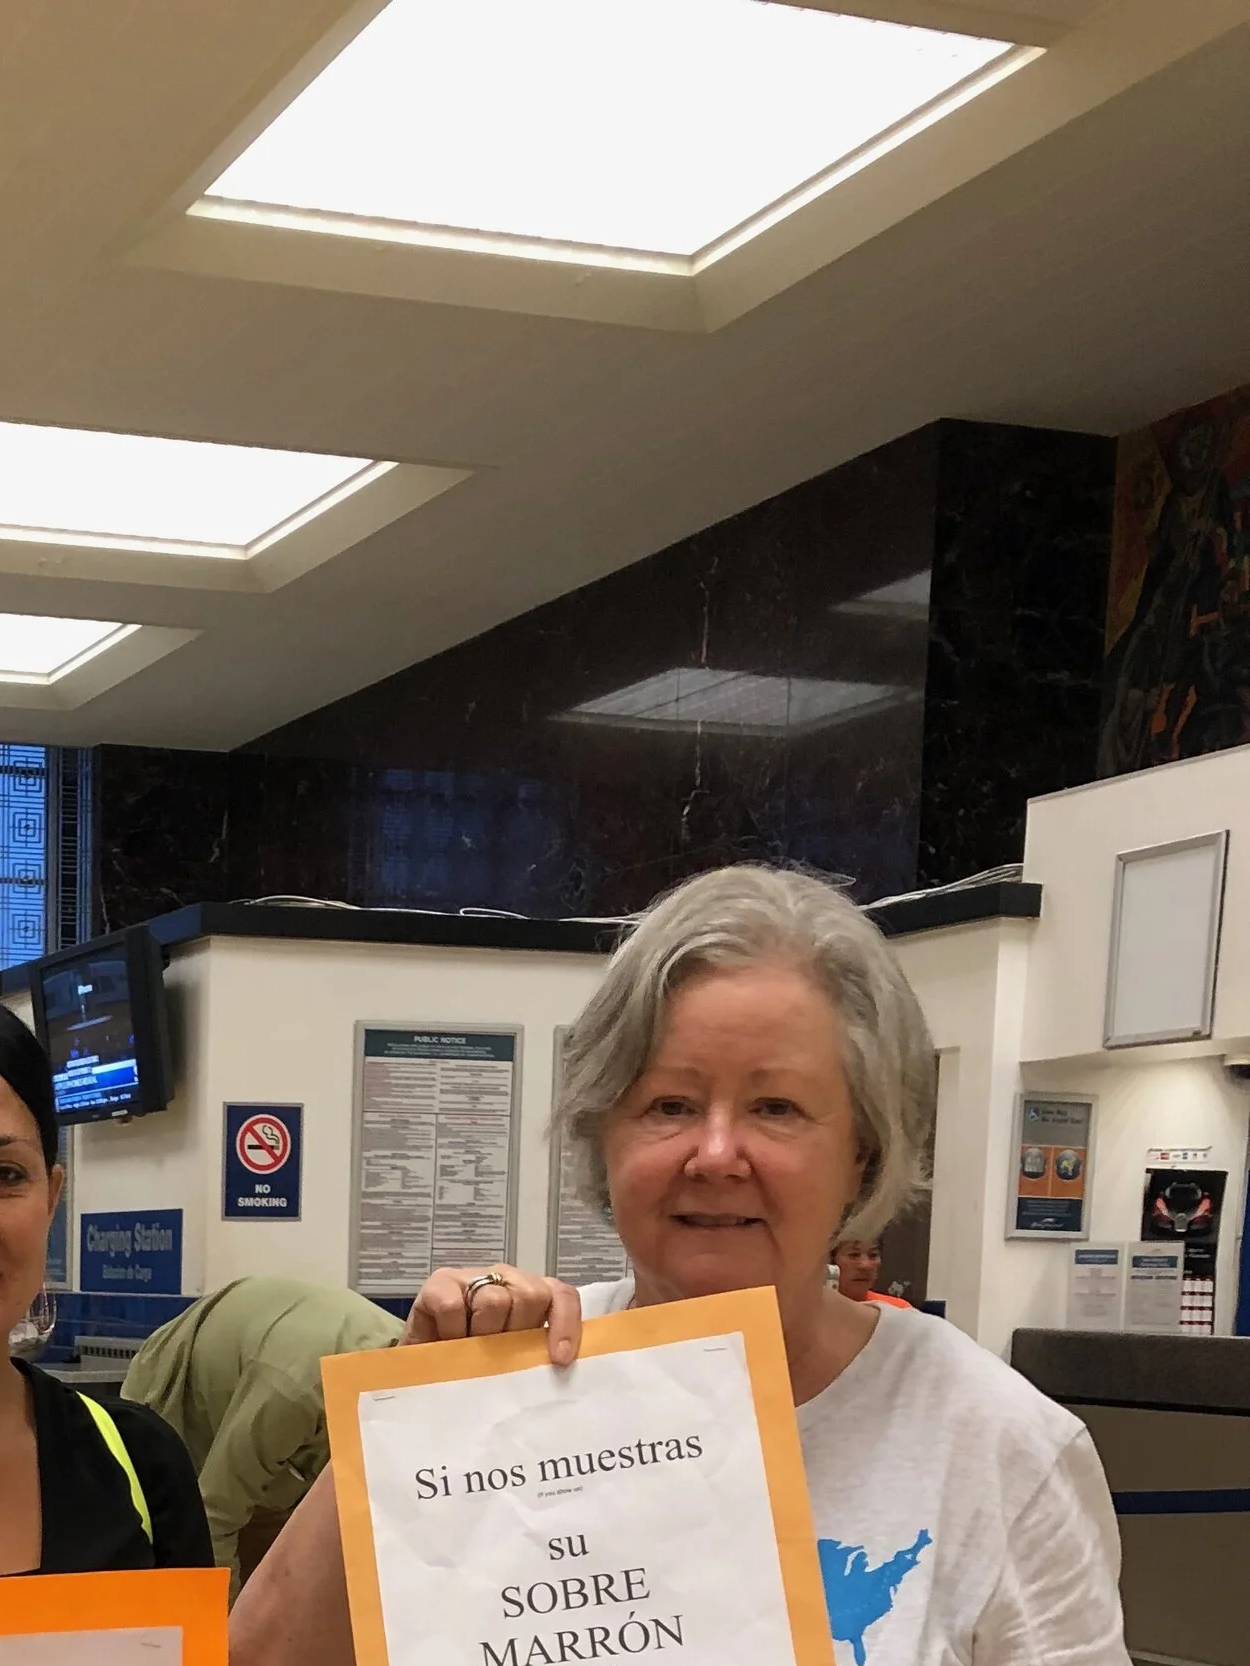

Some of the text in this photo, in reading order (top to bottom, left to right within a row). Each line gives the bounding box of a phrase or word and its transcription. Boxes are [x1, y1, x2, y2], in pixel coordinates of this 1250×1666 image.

[414, 1036, 467, 1045] PUBLIC NOTICE
[238, 1197, 287, 1207] SMOKING
[255, 1184, 271, 1194] NO
[87, 1222, 173, 1258] Charging Station
[415, 1435, 703, 1500] Si nos muestras
[547, 1534, 590, 1561] su
[500, 1567, 651, 1620] SOBRE
